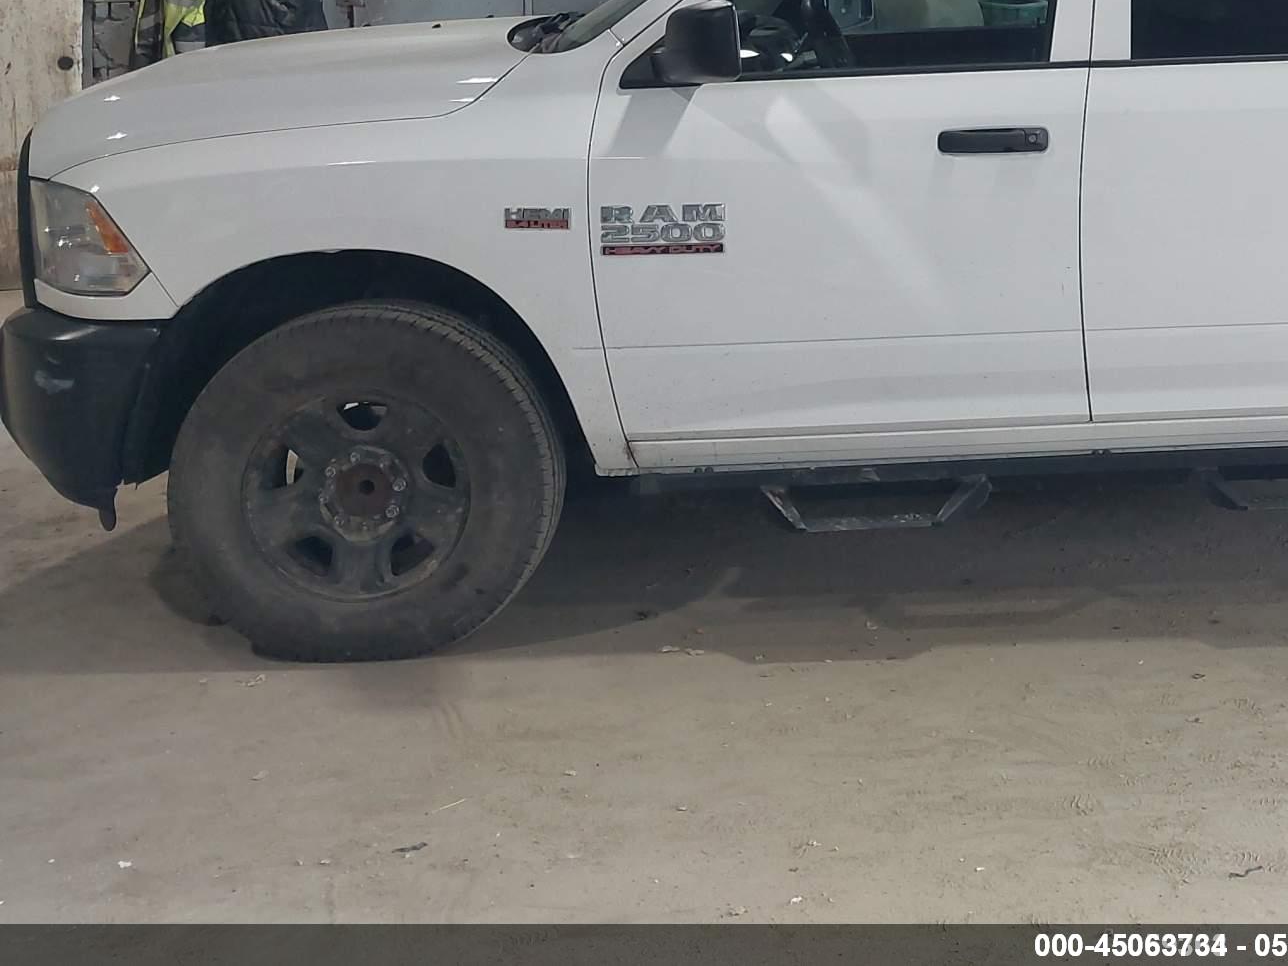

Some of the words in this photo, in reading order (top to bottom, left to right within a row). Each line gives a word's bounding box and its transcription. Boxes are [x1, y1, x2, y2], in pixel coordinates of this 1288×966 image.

[504, 208, 569, 220] HEMI
[600, 203, 725, 223] RAM
[600, 222, 725, 243] 2500
[604, 244, 668, 255] HEAVY
[669, 242, 722, 254] DUTY
